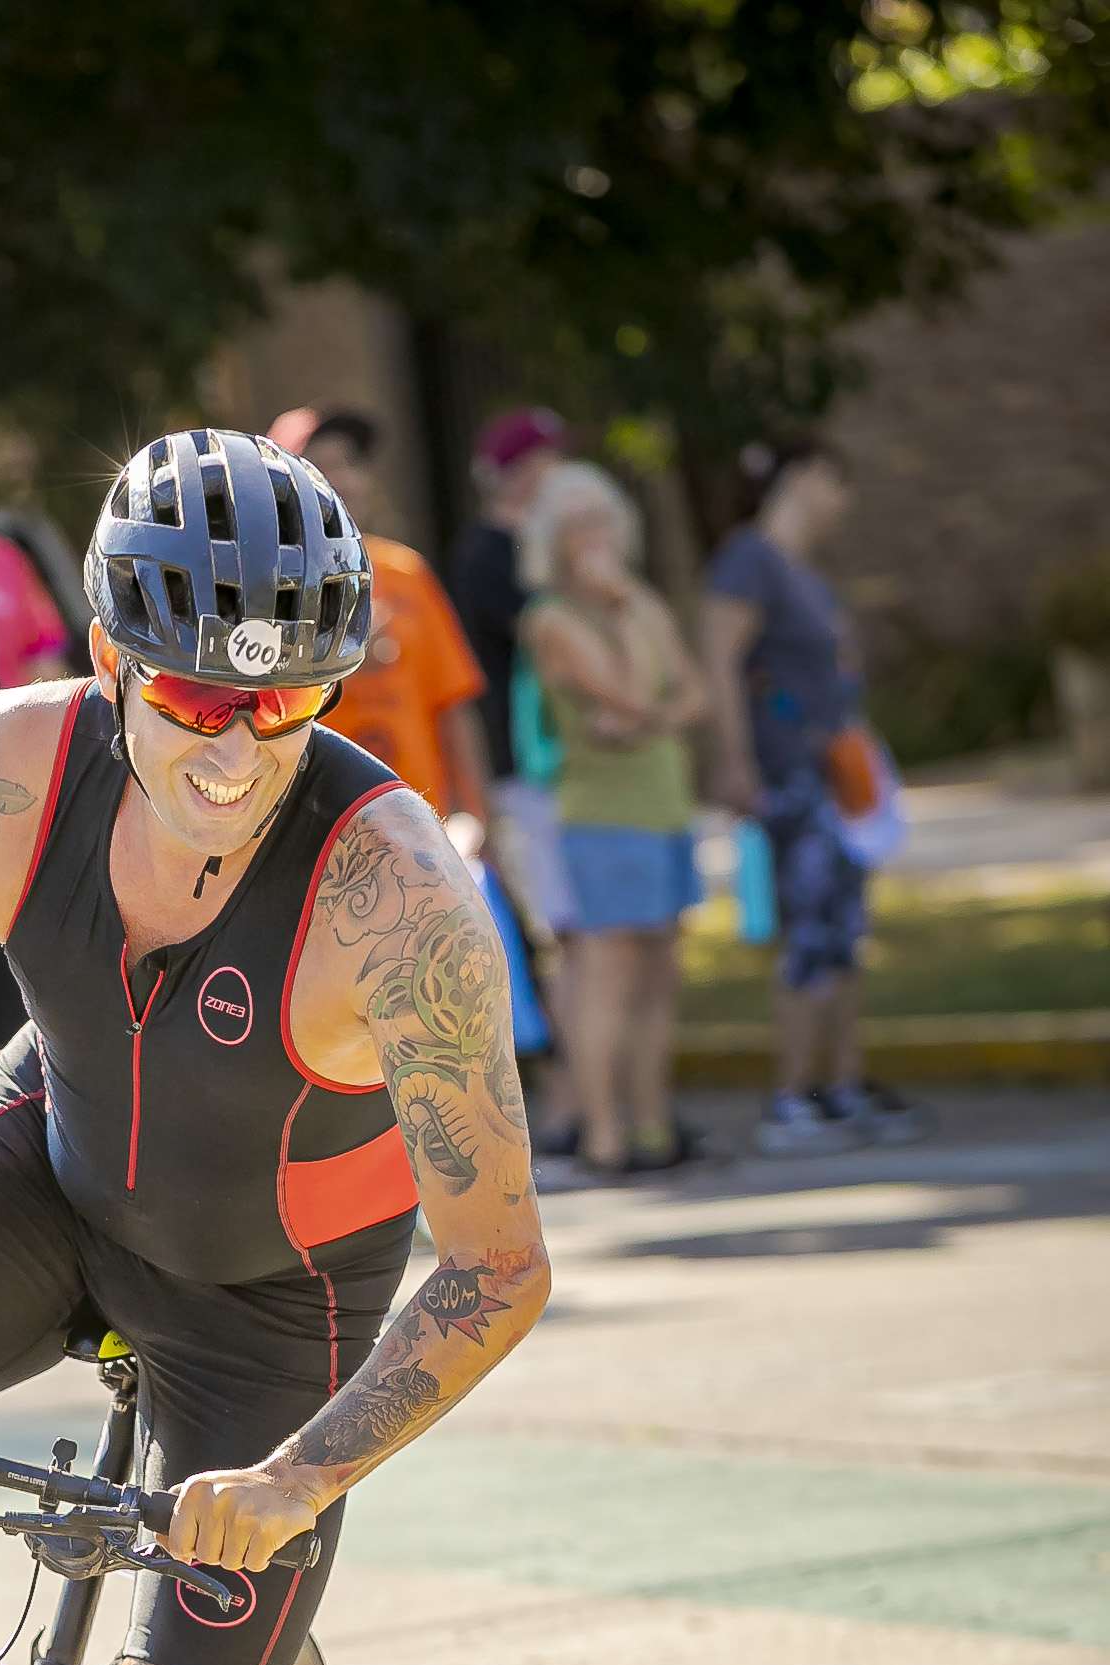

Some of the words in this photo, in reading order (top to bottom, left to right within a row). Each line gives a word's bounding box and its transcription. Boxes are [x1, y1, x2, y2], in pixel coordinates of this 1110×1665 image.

[233, 629, 276, 665] 400
[205, 995, 246, 1018] ZONE3
[426, 1279, 476, 1309] BOOM
